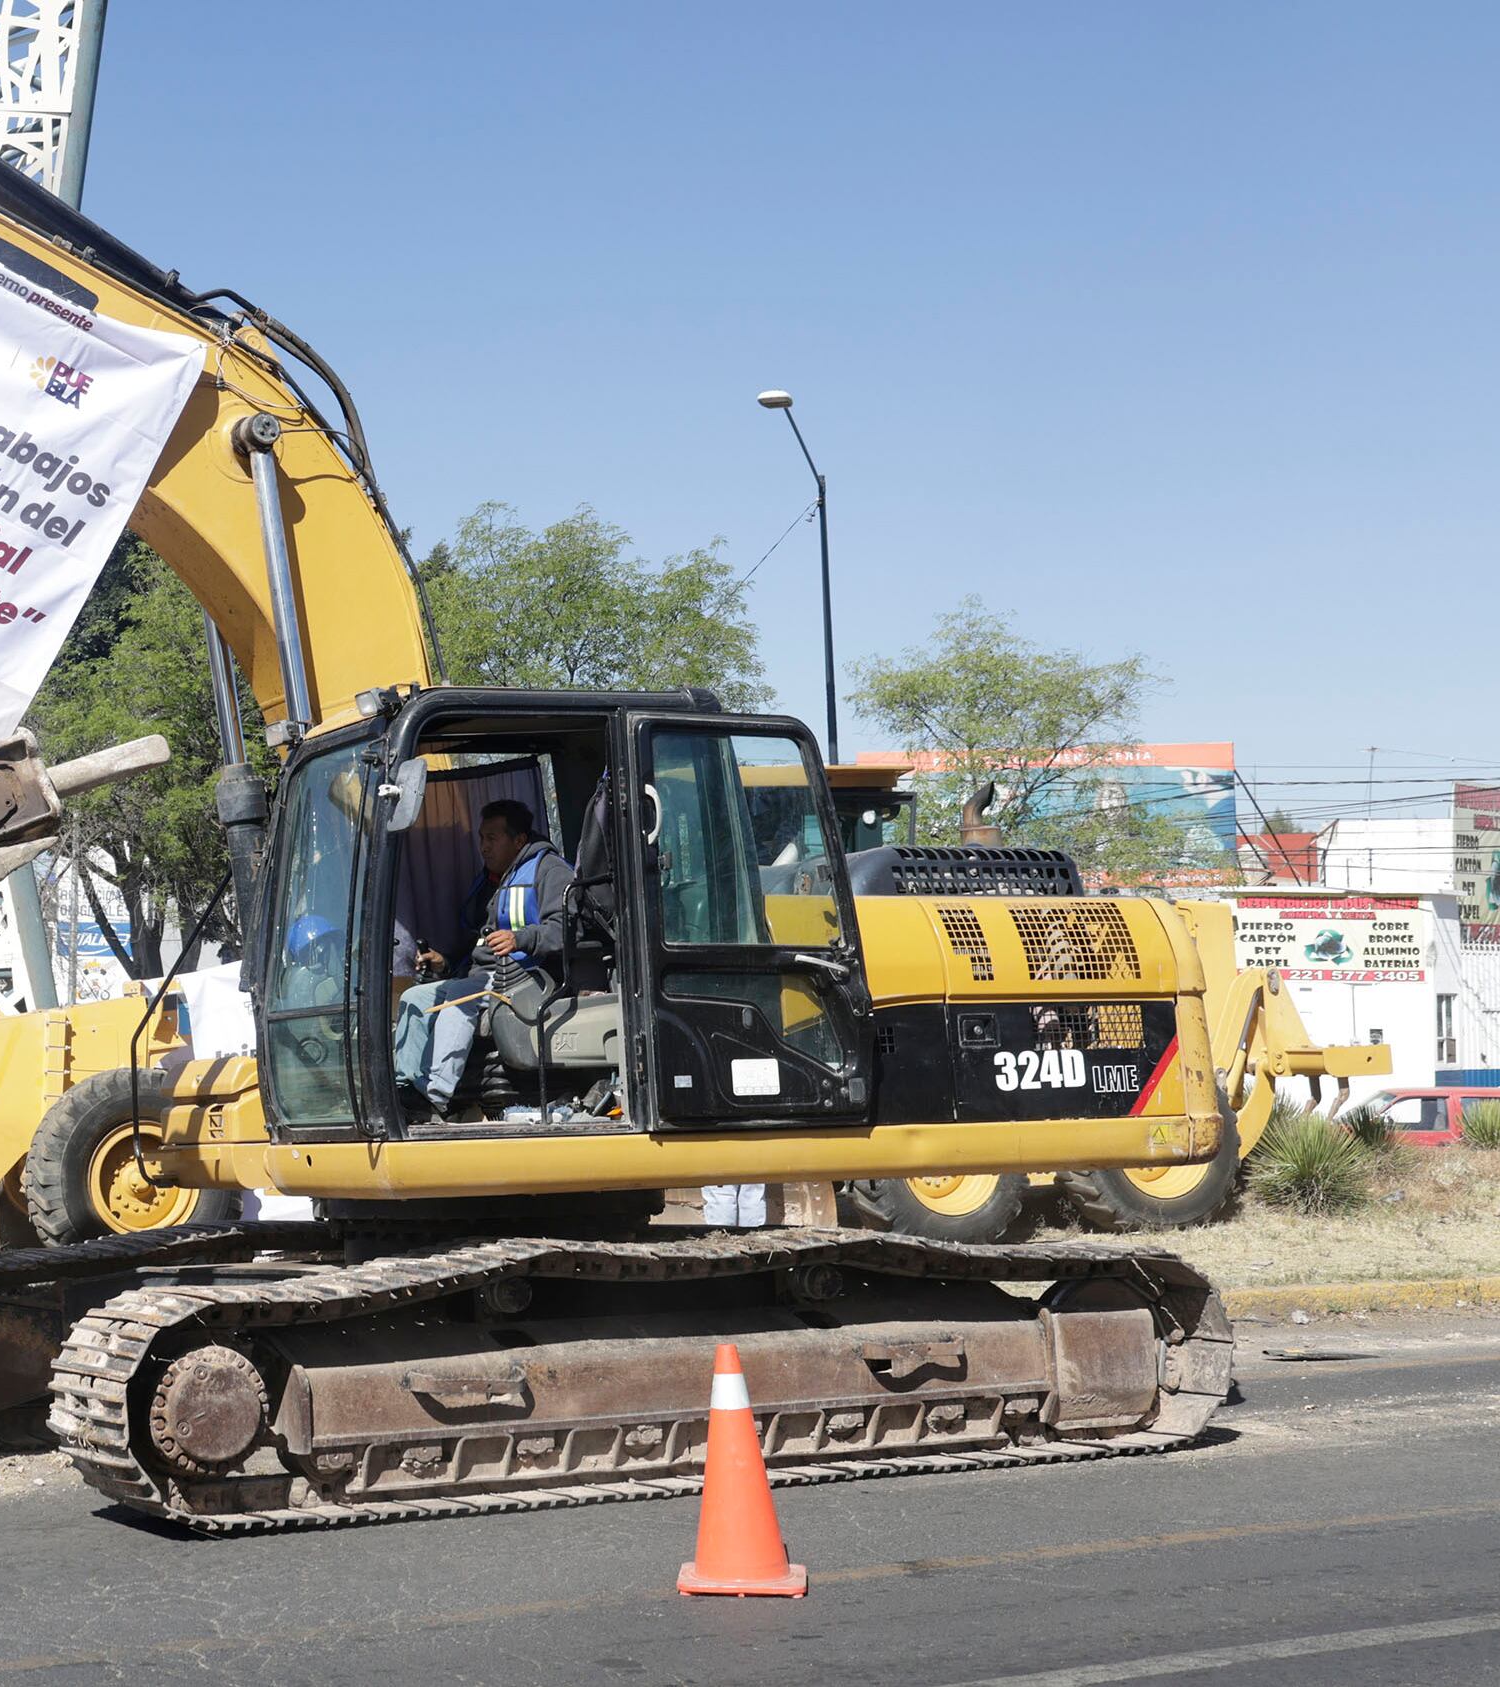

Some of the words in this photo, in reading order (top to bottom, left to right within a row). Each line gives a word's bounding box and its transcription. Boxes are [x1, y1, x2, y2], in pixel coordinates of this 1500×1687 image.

[26, 291, 93, 332] presente
[20, 502, 86, 548] del
[1241, 922, 1294, 931] FIERRO
[1372, 922, 1410, 931] COBRE
[1239, 932, 1296, 943] CARTÓN
[1368, 934, 1414, 943] BRONCE
[1254, 946, 1282, 955] PET
[1363, 946, 1420, 956] ALUMINIO
[1246, 958, 1291, 968] PAPEL
[1364, 958, 1420, 968] BATERÍAS
[1289, 970, 1325, 980] 221
[1331, 970, 1366, 981] 577
[1373, 971, 1420, 981] 3405
[994, 1049, 1086, 1092] 324D
[1092, 1065, 1139, 1093] LME
